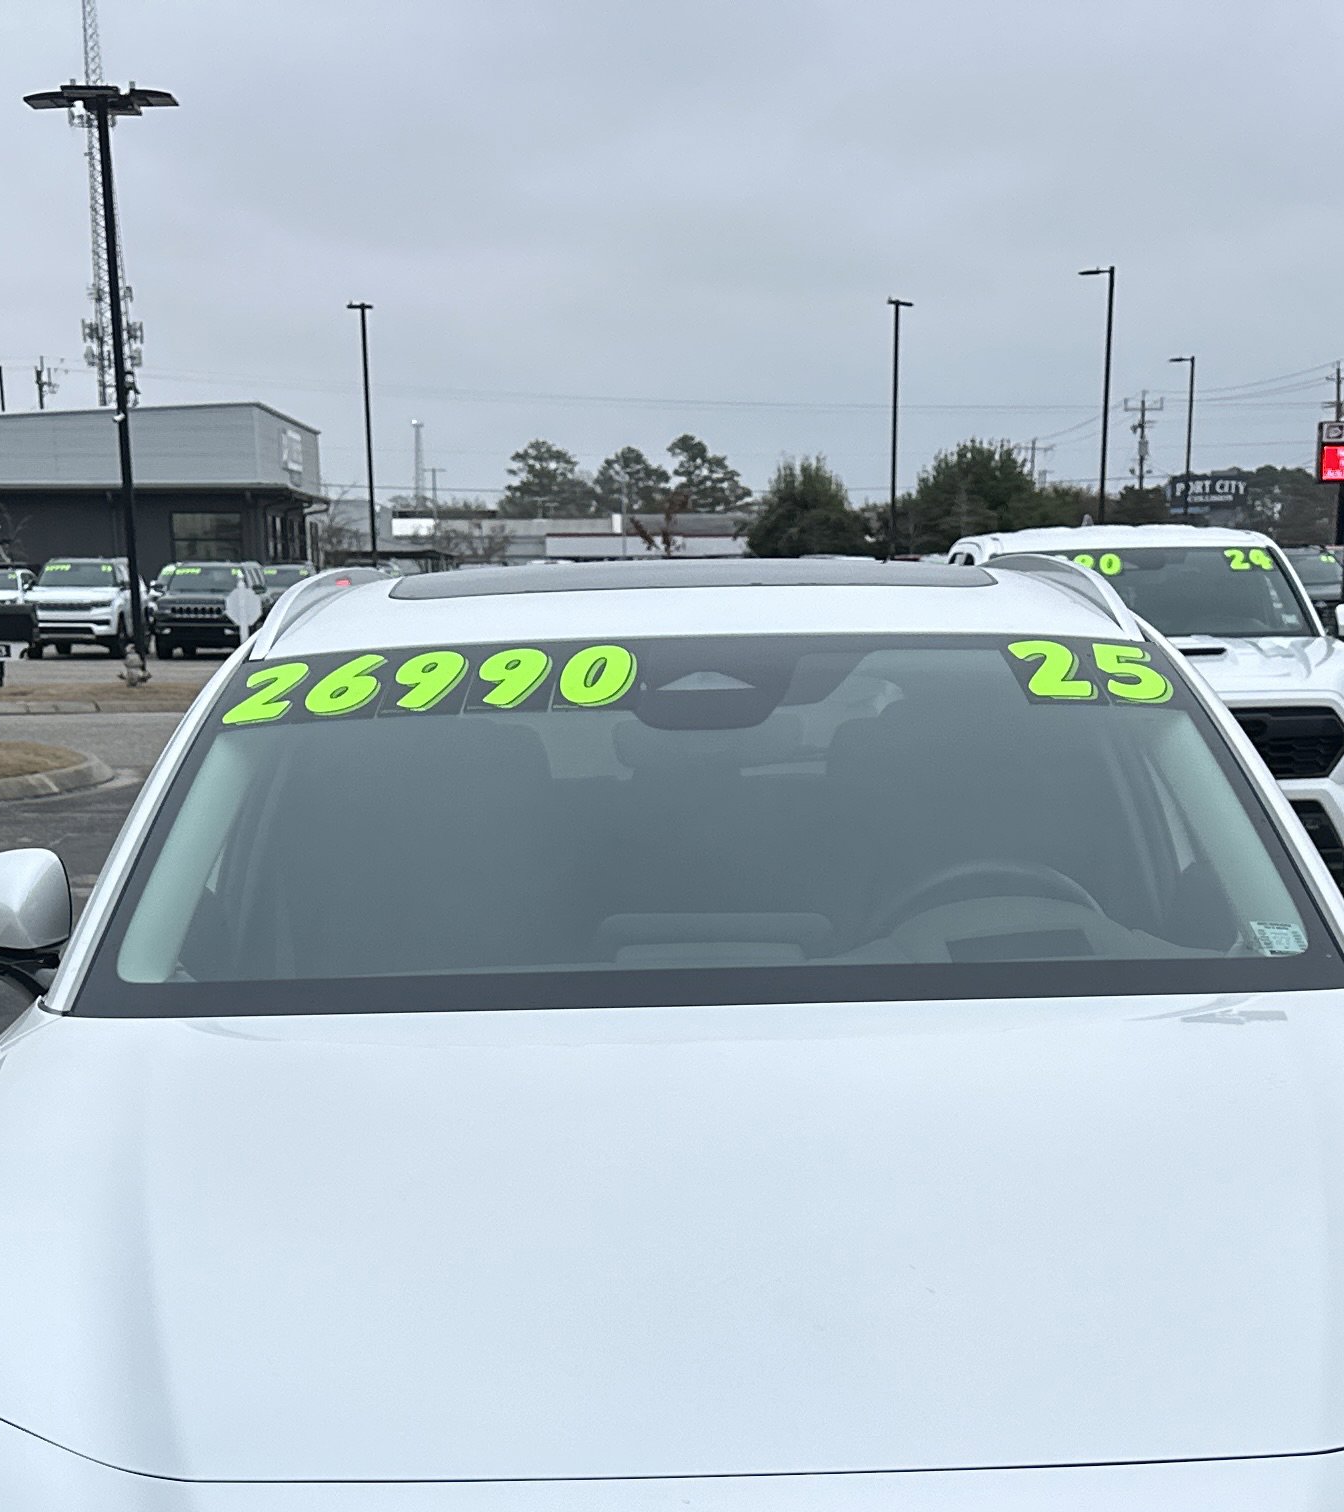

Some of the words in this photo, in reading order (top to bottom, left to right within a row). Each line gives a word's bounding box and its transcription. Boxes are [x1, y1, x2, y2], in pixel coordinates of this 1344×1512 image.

[1215, 479, 1247, 495] CITY
[222, 645, 637, 726] 26990
[1007, 640, 1174, 704] 25
